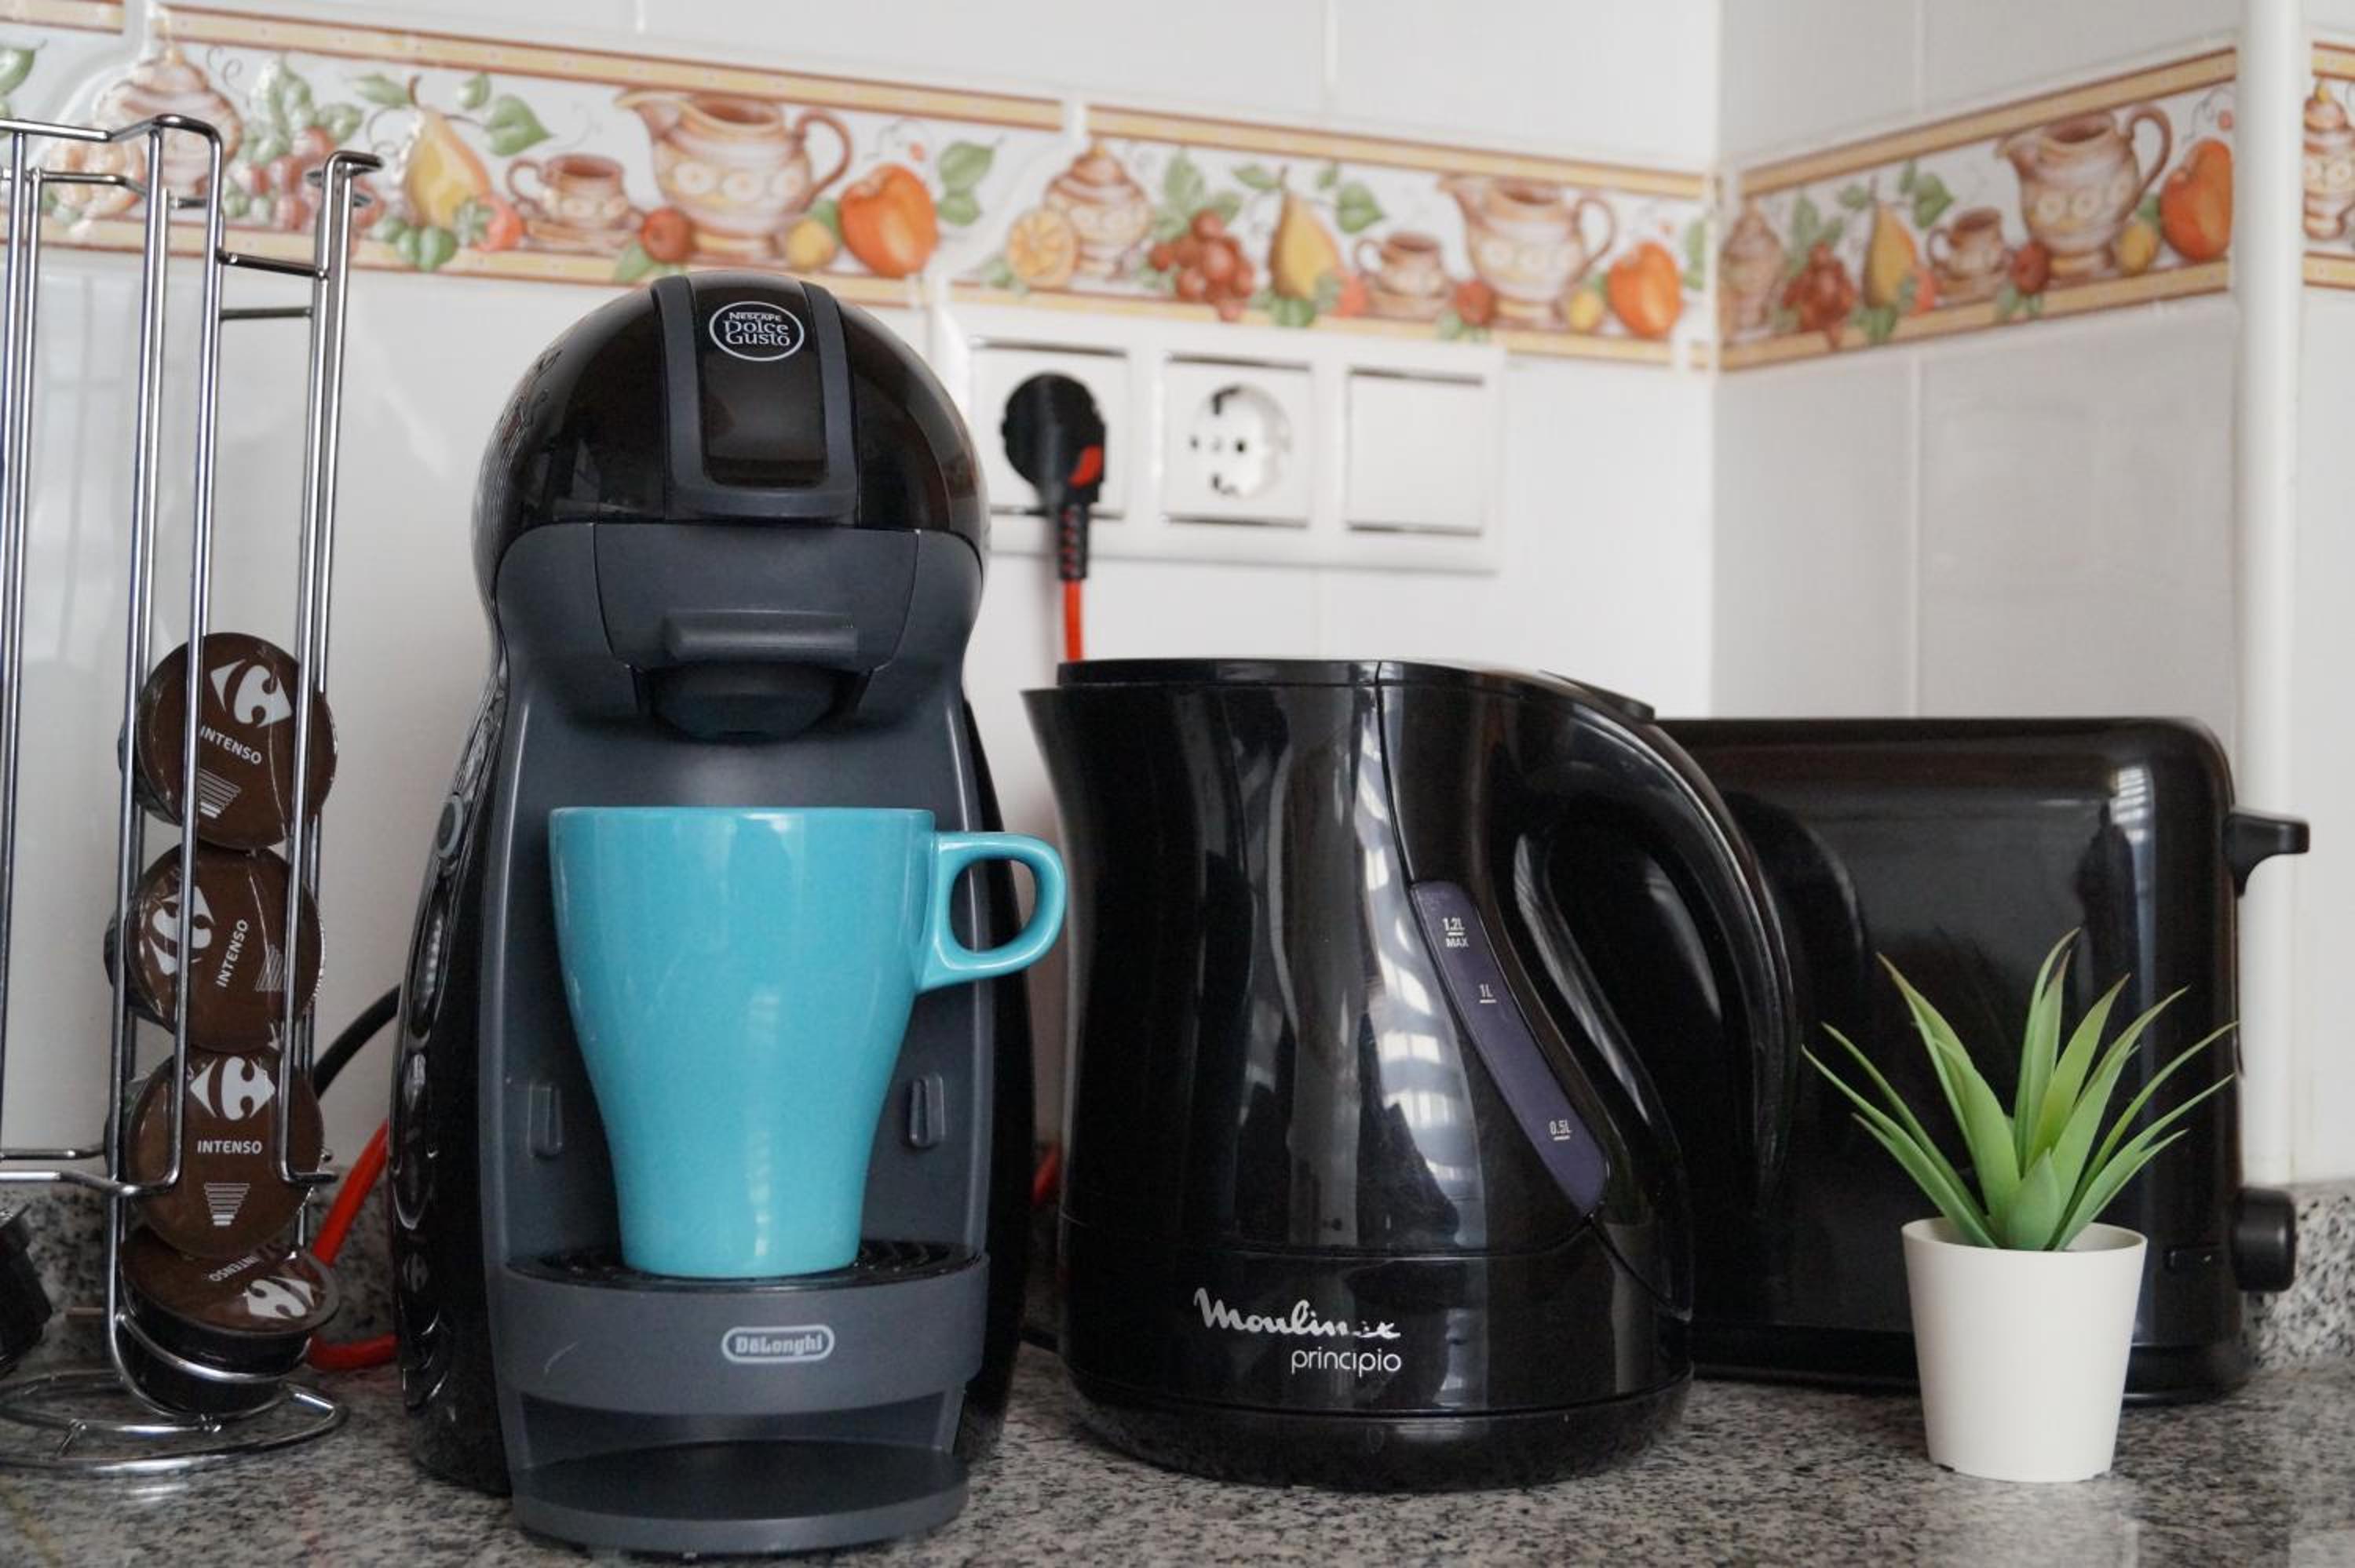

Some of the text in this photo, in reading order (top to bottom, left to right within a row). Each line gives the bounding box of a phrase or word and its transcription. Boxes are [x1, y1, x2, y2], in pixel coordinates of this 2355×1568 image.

[723, 319, 789, 335] Dolce
[725, 331, 790, 346] Gusto
[200, 725, 262, 765] INTENSO
[1445, 938, 1469, 948] MAX
[216, 919, 249, 987] INTENSO
[1479, 983, 1493, 997] 1L
[1549, 1118, 1572, 1136] 0.5L
[197, 1140, 262, 1154] INTENSO
[1192, 1287, 1401, 1339] Moulinx
[1291, 1346, 1402, 1377] principio
